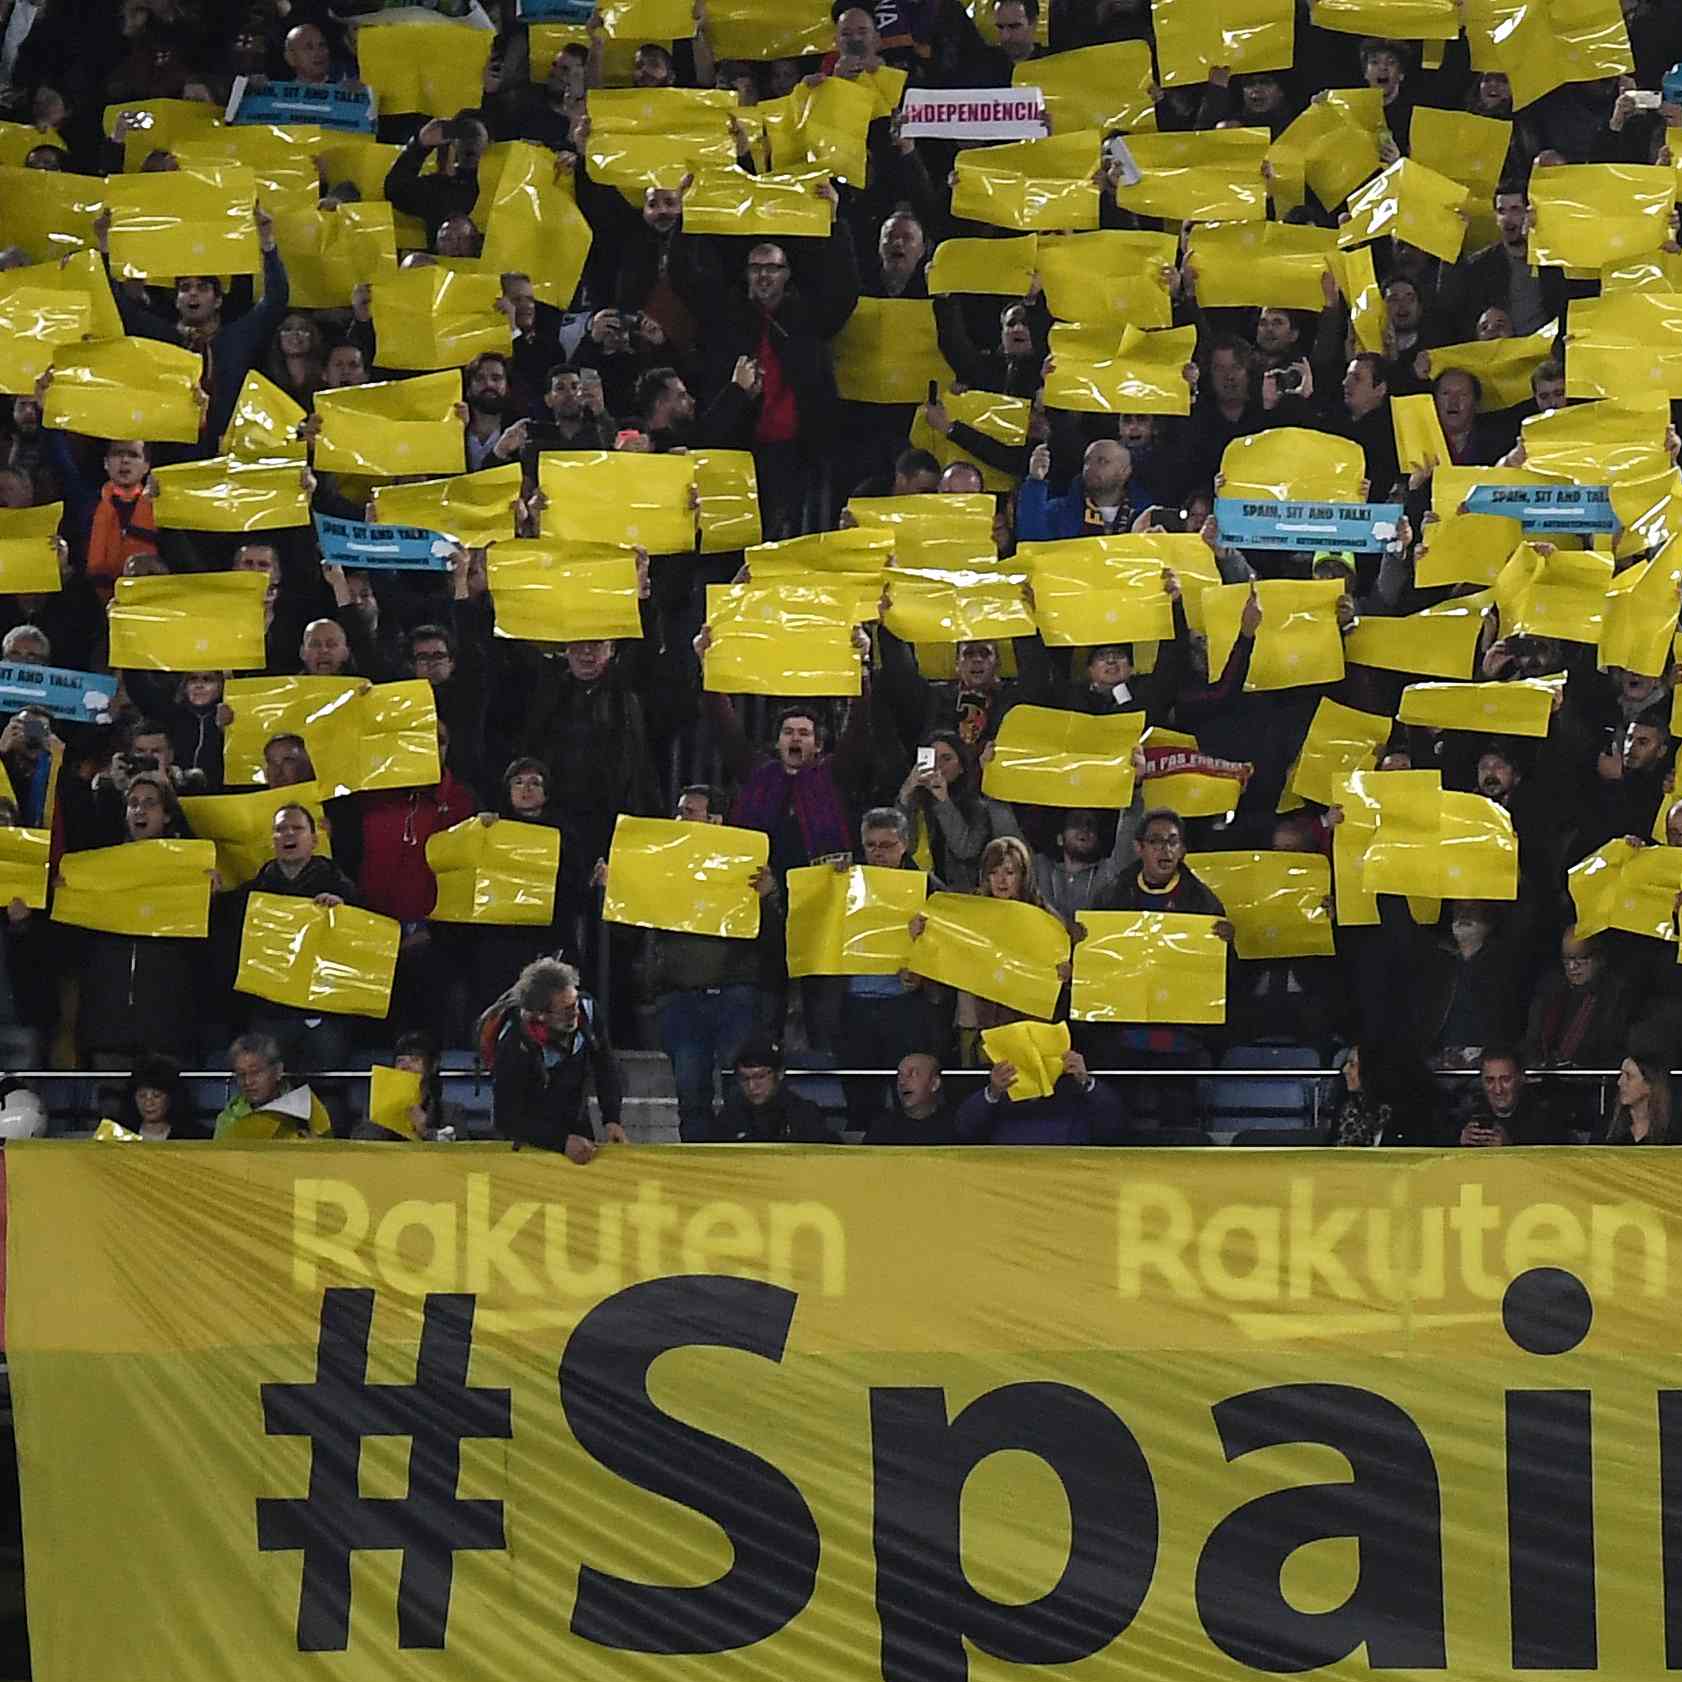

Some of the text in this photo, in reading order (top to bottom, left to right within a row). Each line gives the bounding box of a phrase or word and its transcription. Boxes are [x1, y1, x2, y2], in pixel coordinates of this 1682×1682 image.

[1241, 503, 1372, 521] SPAIN, SIT AND TALK!
[292, 1176, 847, 1296] Rakuten
[1117, 1178, 1668, 1302] Rakuten
